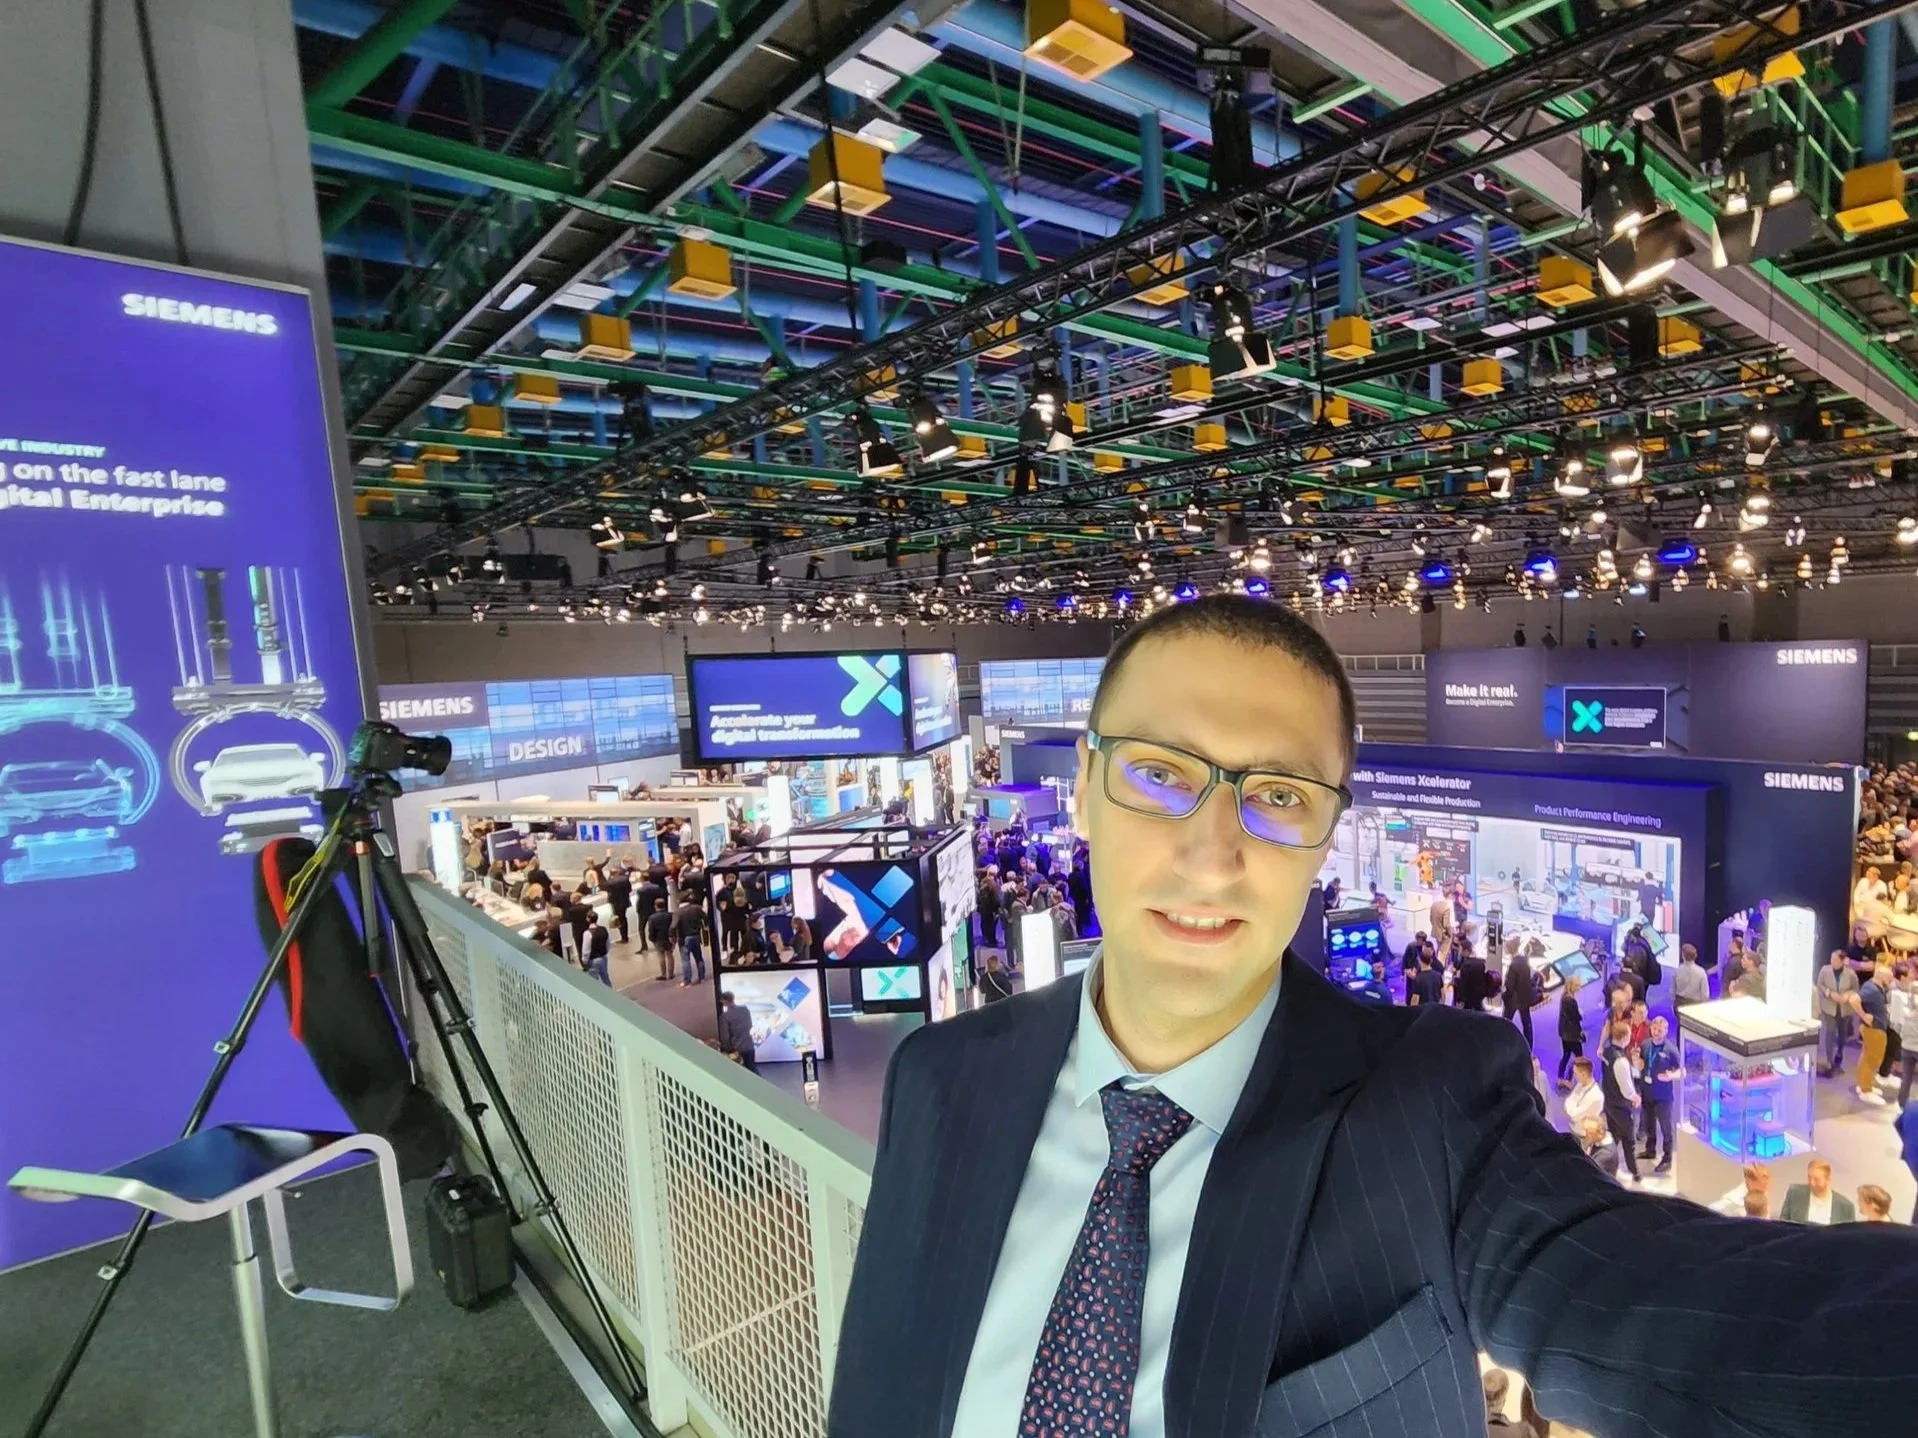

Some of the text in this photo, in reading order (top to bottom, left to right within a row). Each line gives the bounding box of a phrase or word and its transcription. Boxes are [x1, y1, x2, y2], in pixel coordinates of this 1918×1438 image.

[122, 293, 278, 335] SIEMENS
[13, 463, 54, 481] on
[59, 462, 109, 485] the
[113, 465, 166, 488] fast
[170, 469, 226, 492] lane
[69, 489, 225, 518] Enterprise
[1777, 648, 1858, 665] SIEMENS
[1445, 683, 1518, 697] Make it real.
[379, 696, 473, 720] SIEMENS
[1071, 698, 1092, 713] RE
[710, 714, 817, 729] Accelerate your
[711, 725, 861, 746] digital transformation
[509, 736, 583, 761] DESIGN
[1353, 770, 1471, 790] with Siemens Xcelerator
[1764, 772, 1844, 792] SIEMENS
[1371, 790, 1481, 809] Sustainable and Flexible Production
[1534, 804, 1662, 829] Product Performance Engineering
